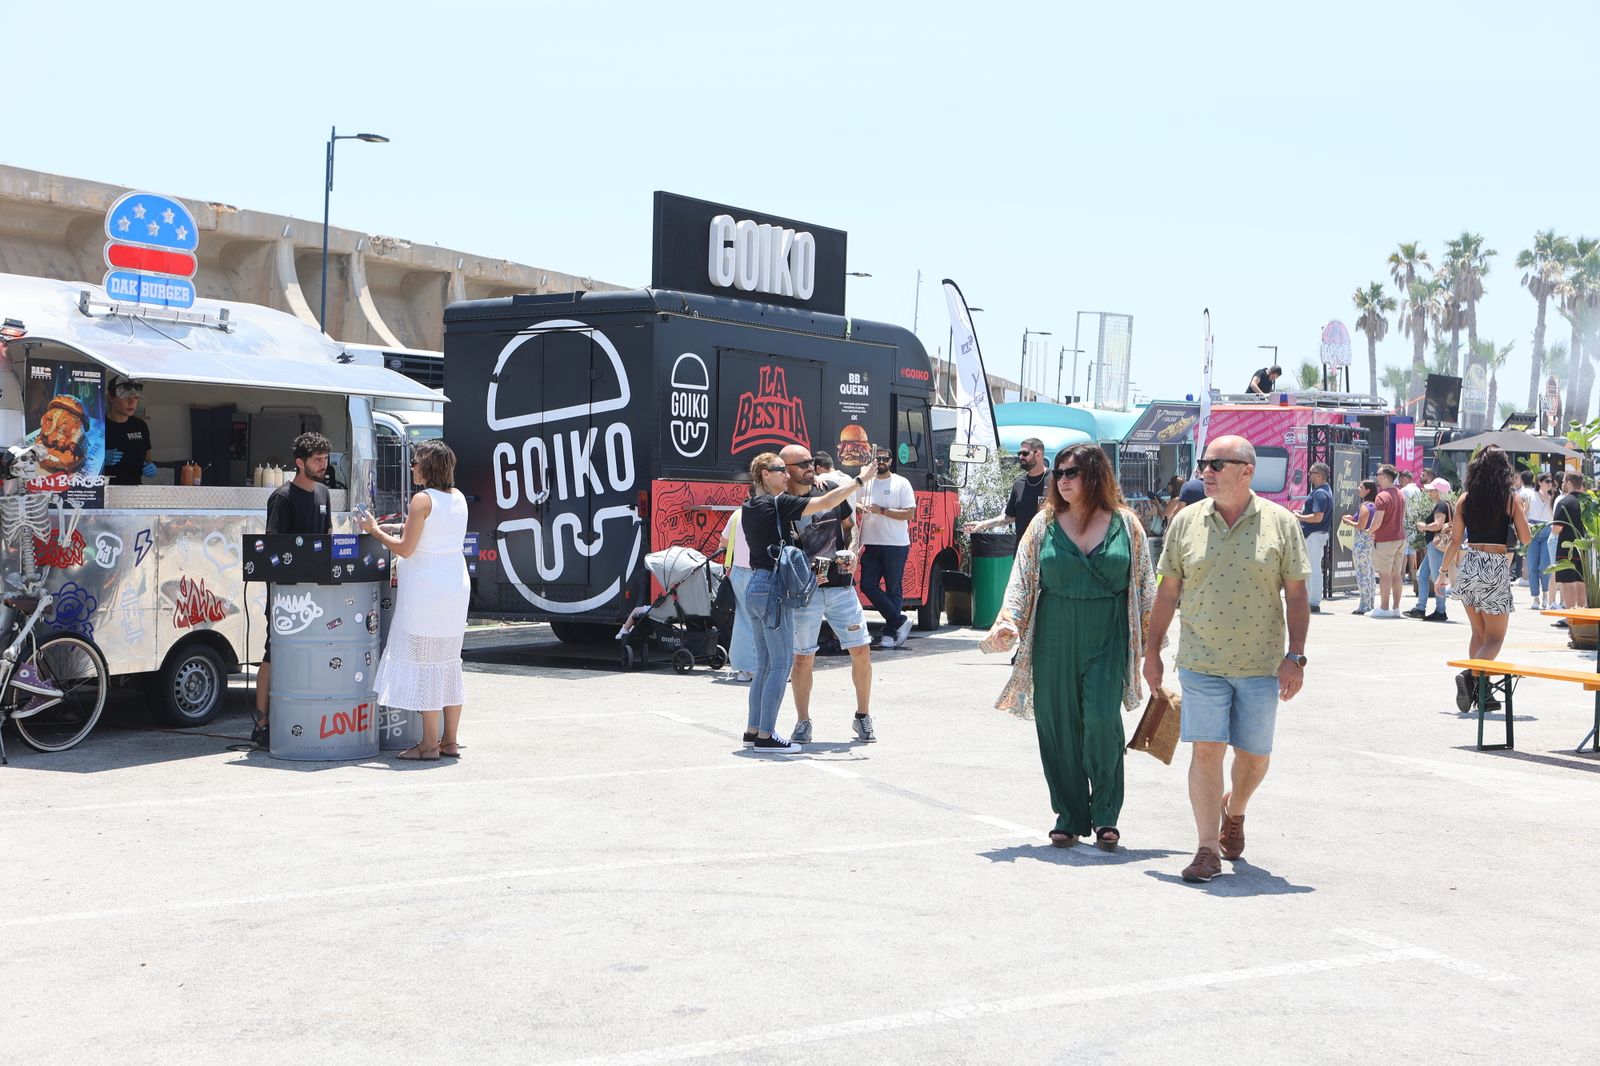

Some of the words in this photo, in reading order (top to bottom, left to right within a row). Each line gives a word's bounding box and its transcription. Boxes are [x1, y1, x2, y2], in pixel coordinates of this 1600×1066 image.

[708, 214, 816, 300] GOIKO
[111, 277, 138, 296] DAK
[141, 281, 190, 302] BURGER
[759, 365, 788, 399] LA
[840, 383, 869, 396] QUEEN
[848, 372, 861, 384] BB
[671, 391, 709, 419] GOIKO
[734, 391, 809, 443] BESTIA
[492, 421, 636, 510] GOIKO
[319, 702, 375, 739] LOVE!
